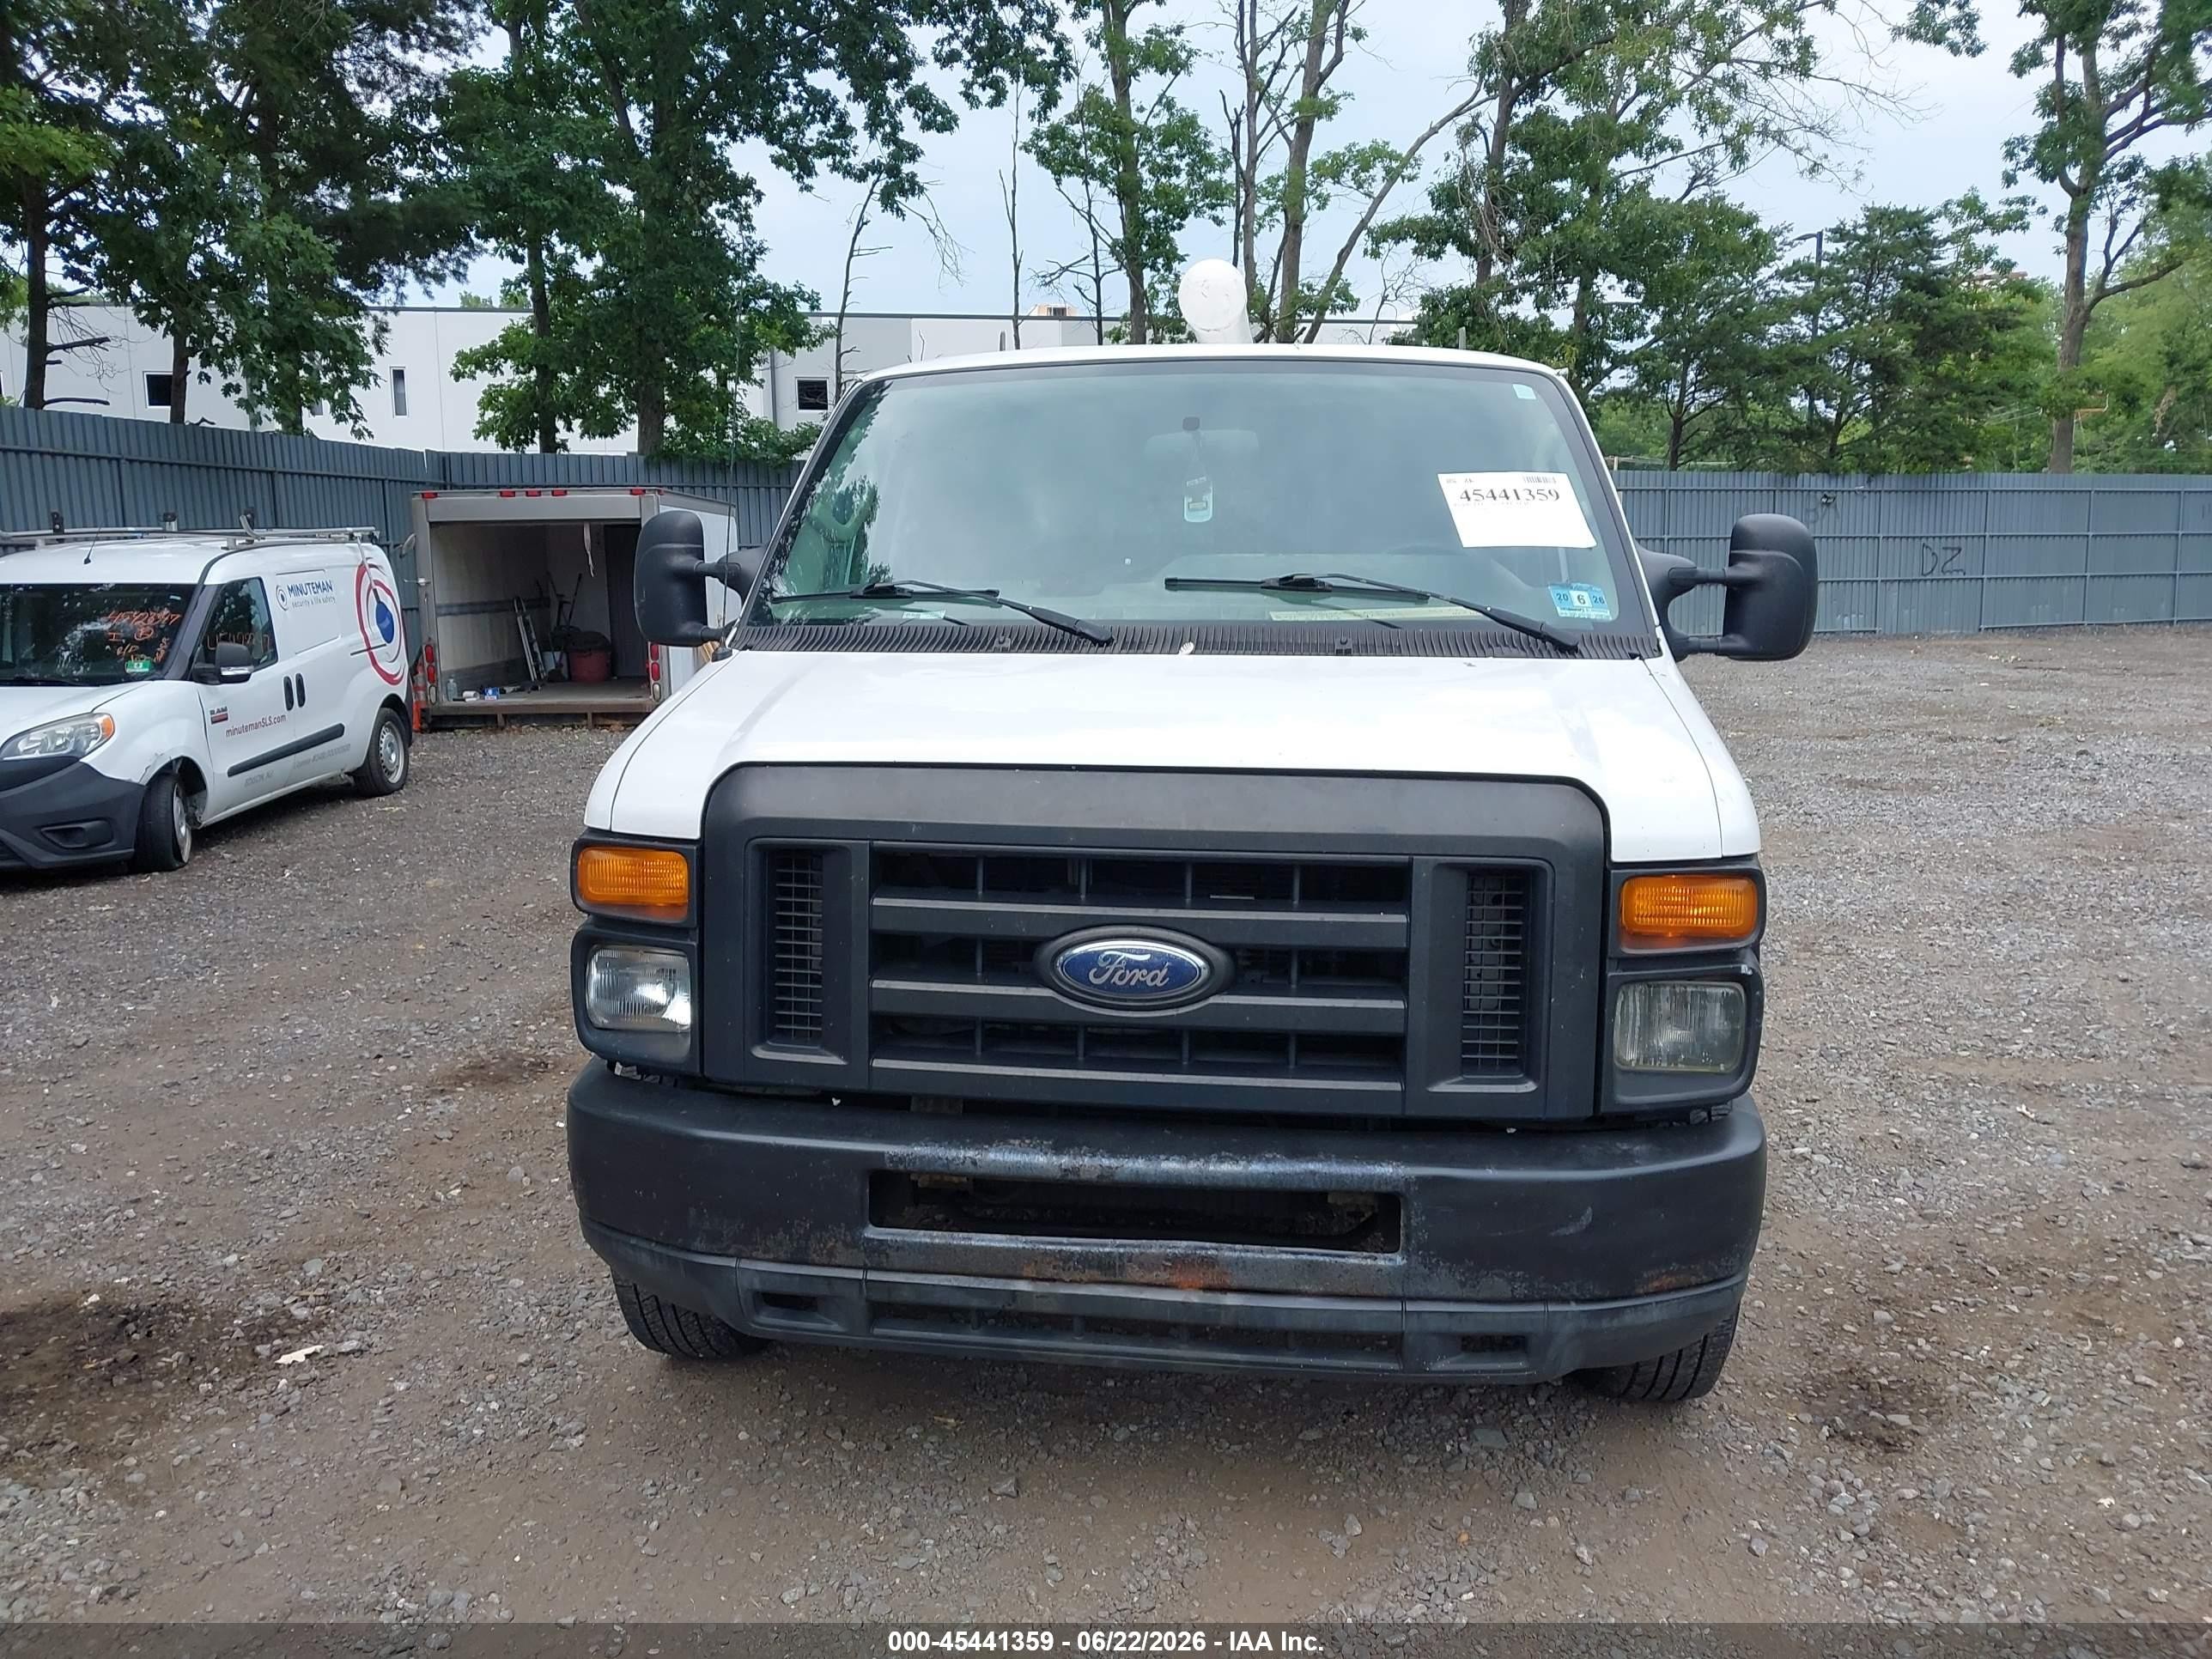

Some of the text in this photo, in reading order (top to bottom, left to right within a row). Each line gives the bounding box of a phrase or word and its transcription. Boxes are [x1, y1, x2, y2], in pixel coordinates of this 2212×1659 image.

[1460, 489, 1559, 501] 45441359
[1921, 543, 1966, 576] DZ
[287, 580, 333, 598] MINUTEMAN
[1556, 592, 1569, 601] 20
[1577, 594, 1586, 605] 6
[210, 706, 228, 714] RAM
[226, 714, 286, 738] minutemanSLS.com
[1089, 951, 1169, 987] Ford
